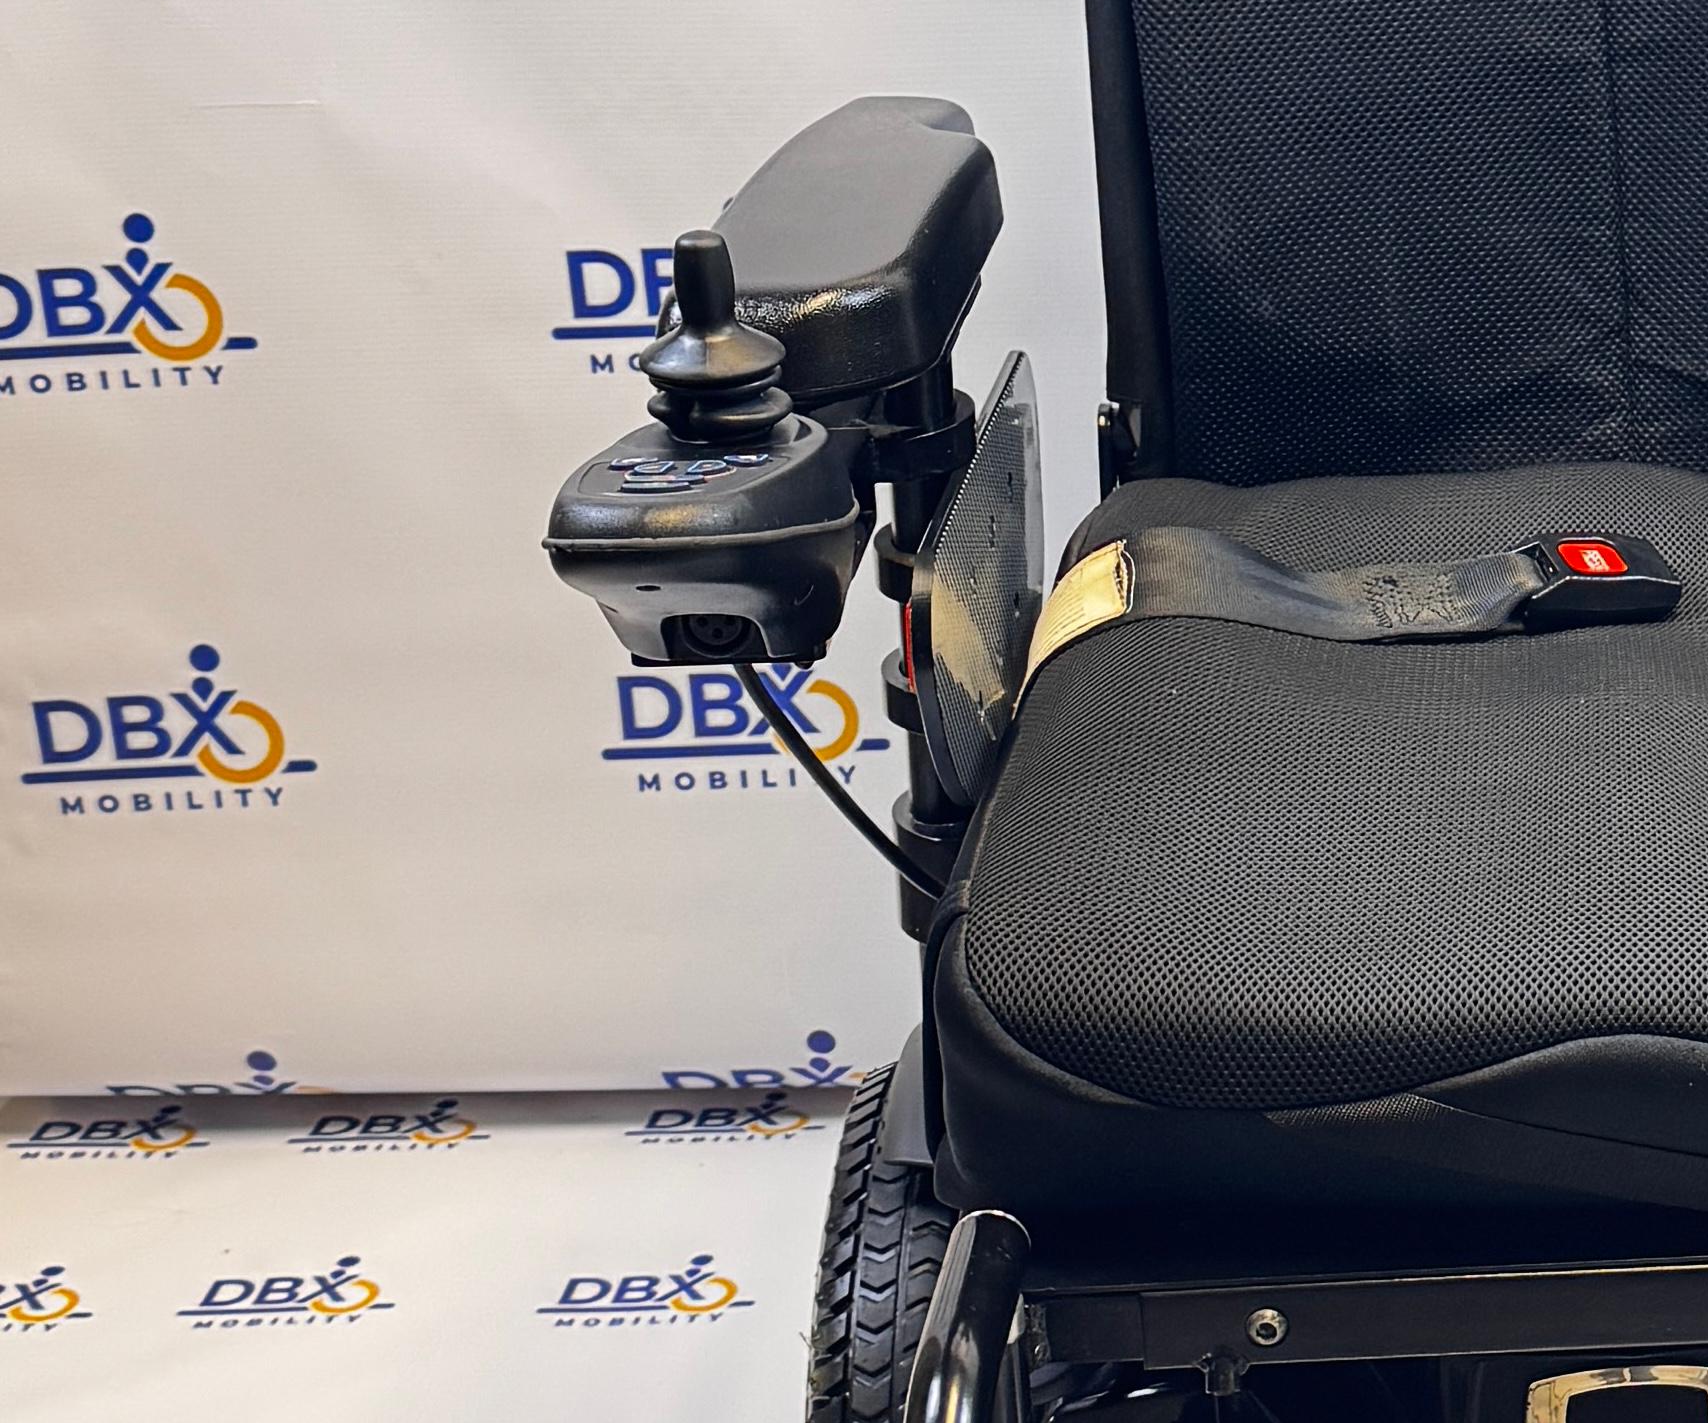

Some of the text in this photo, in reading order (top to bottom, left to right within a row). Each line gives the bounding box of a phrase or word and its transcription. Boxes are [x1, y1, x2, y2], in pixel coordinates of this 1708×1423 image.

[31, 689, 245, 765] DBX
[638, 765, 857, 793] MOBILIY
[59, 787, 283, 816] MOBILITY
[199, 1274, 359, 1307] DBX
[558, 1271, 715, 1305] DBX
